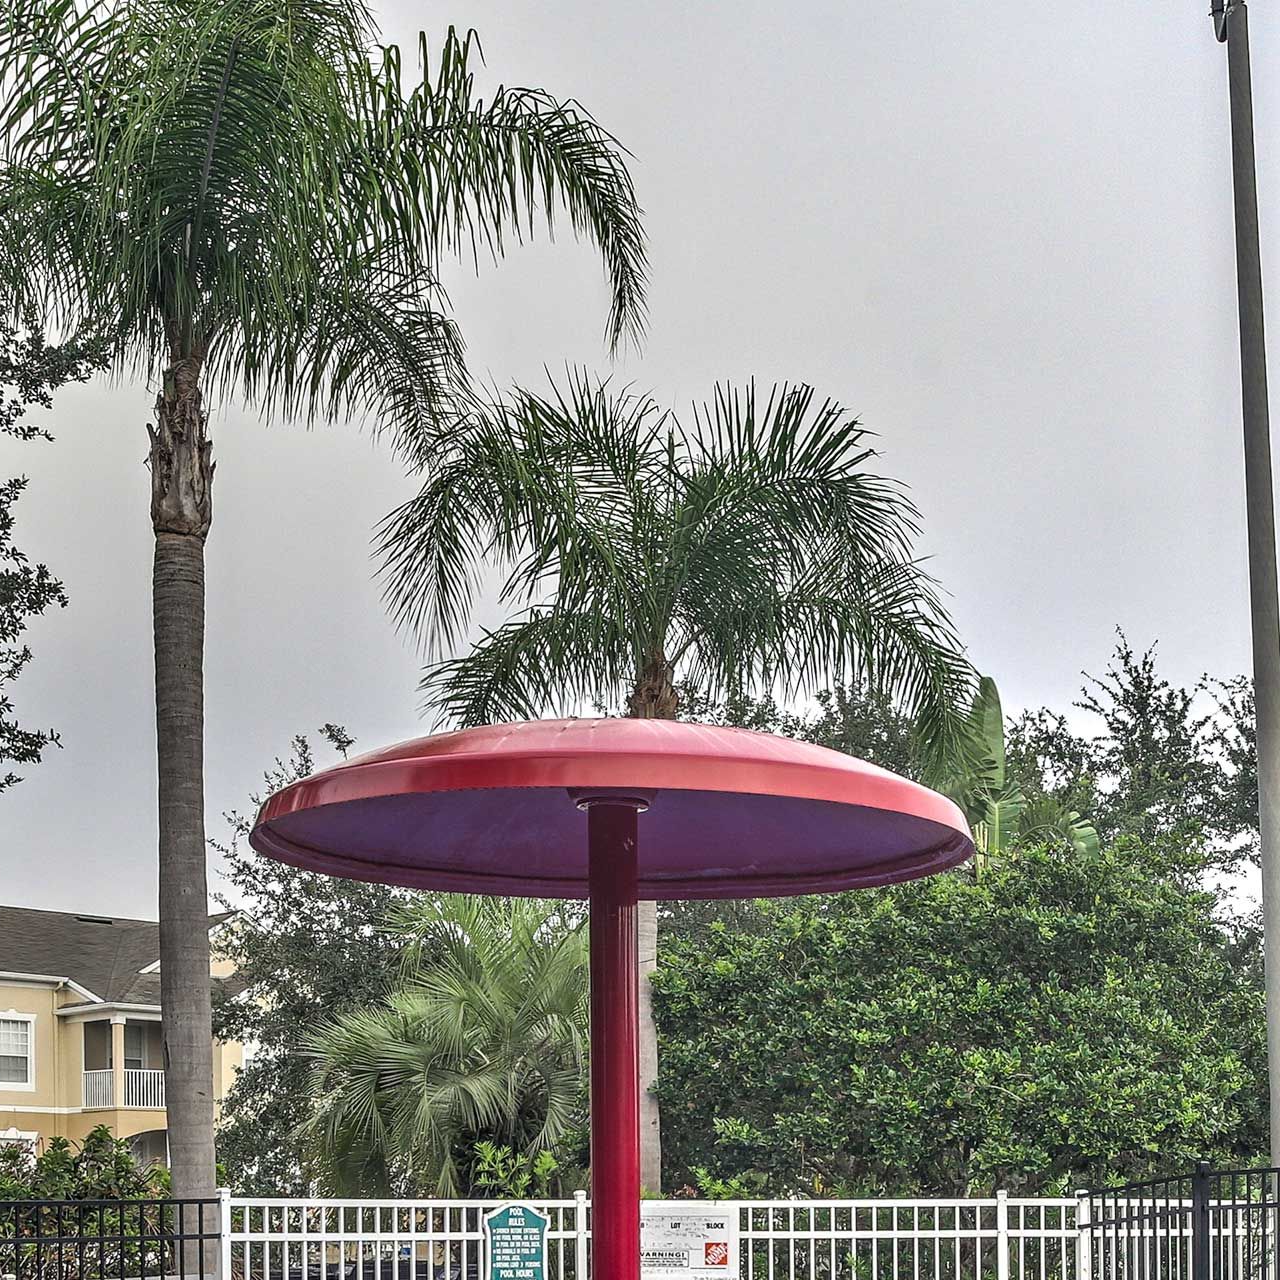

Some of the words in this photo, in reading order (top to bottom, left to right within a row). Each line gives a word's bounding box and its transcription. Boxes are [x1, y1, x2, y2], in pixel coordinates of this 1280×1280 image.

[510, 1208, 523, 1216] POOL
[509, 1218, 524, 1226] RULES
[500, 1270, 514, 1278] POOL
[516, 1270, 533, 1278] HOURS
